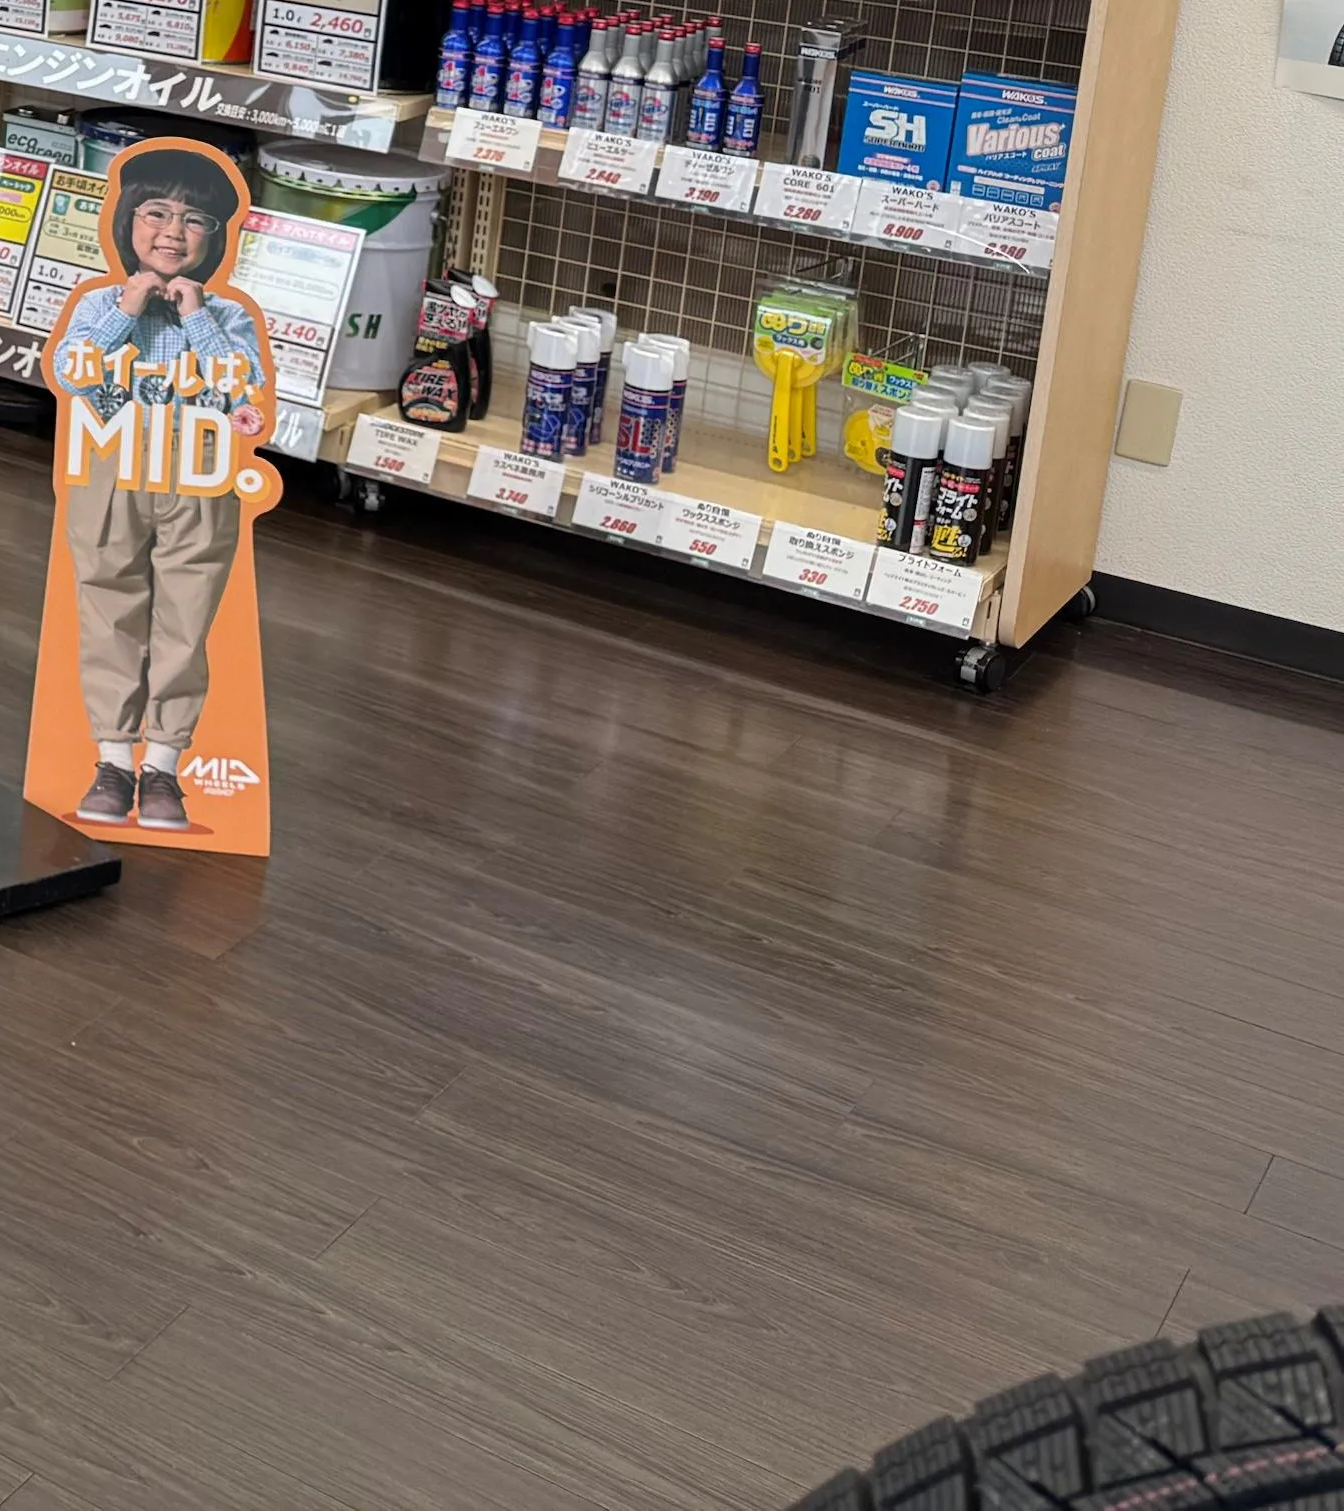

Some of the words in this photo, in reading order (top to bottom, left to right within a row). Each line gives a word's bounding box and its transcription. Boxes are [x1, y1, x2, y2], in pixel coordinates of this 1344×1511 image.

[864, 109, 926, 145] SH
[595, 134, 632, 147] WAKO'S
[967, 123, 1063, 156] Various
[692, 151, 732, 164] WAKO'S
[791, 168, 832, 182] WAKO'S
[783, 178, 810, 190] CORE
[816, 183, 835, 193] 601
[892, 187, 933, 200] WAKO'S
[881, 195, 940, 212] スーパーハード
[993, 204, 1036, 218] WAKO'S
[984, 213, 1041, 230] バリアスコート
[882, 224, 924, 241] 8,900
[60, 340, 265, 404] ホイールは、
[413, 371, 447, 386] TIRE
[423, 383, 458, 400] WAX
[374, 430, 396, 441] TIRE
[399, 435, 418, 447] WAX
[503, 452, 540, 468] WAKO'S
[609, 479, 649, 496] WAKO'S
[682, 507, 741, 530] ワックススポンジ
[688, 538, 717, 556] 550
[798, 568, 828, 586] 330
[899, 595, 940, 616] 2,750
[180, 755, 260, 783] MID
